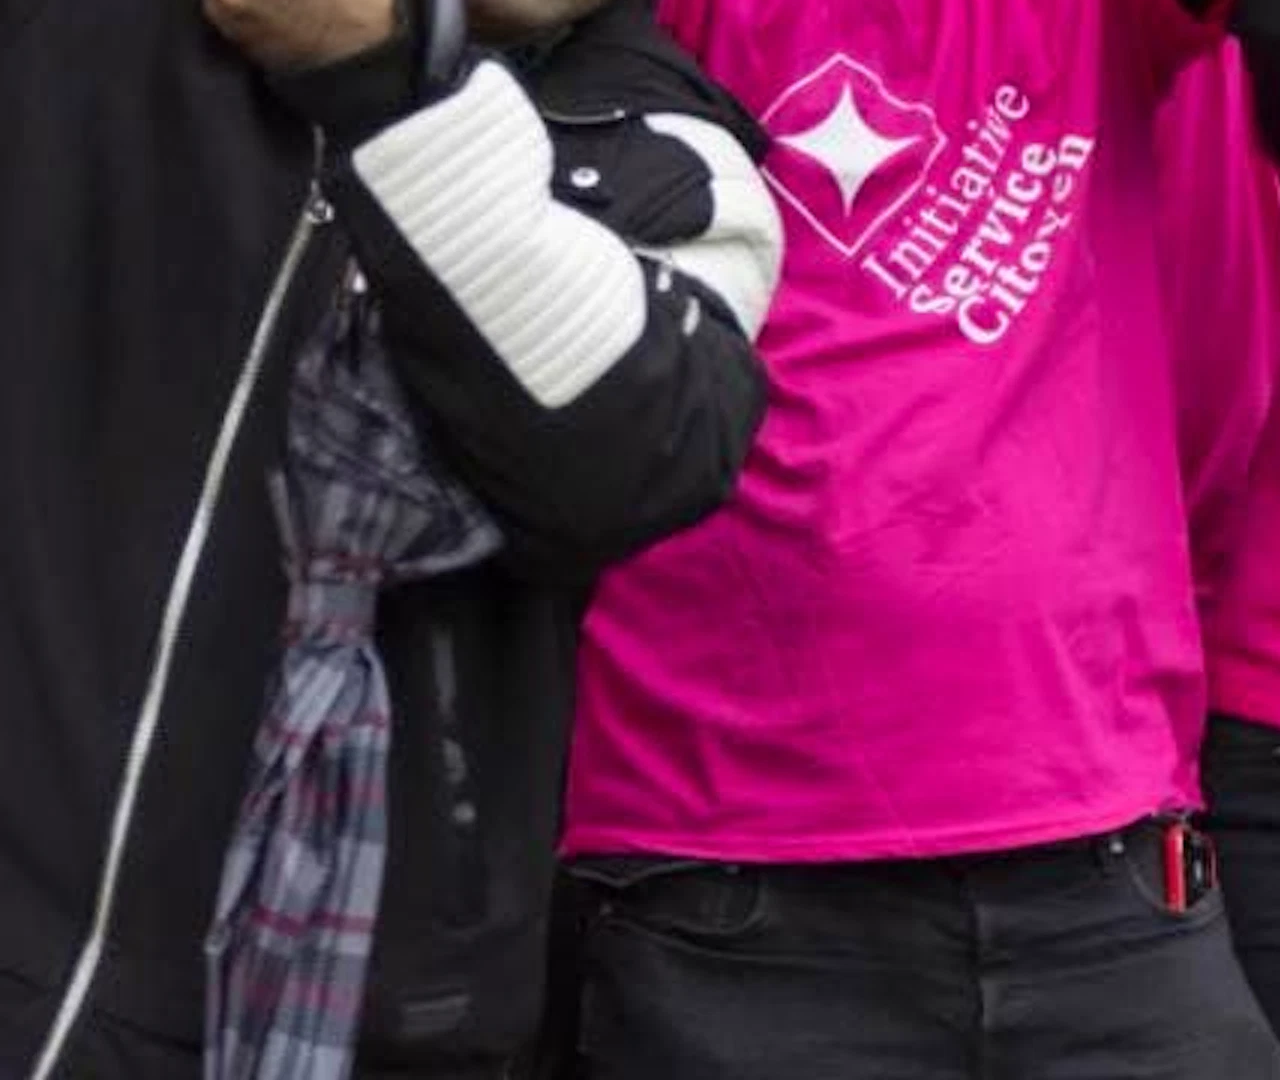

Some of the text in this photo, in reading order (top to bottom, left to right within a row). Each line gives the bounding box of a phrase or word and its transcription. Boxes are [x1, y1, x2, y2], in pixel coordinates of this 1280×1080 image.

[860, 83, 1030, 300] Initiative
[908, 142, 1057, 317] Service
[957, 133, 1096, 344] Citoyen
